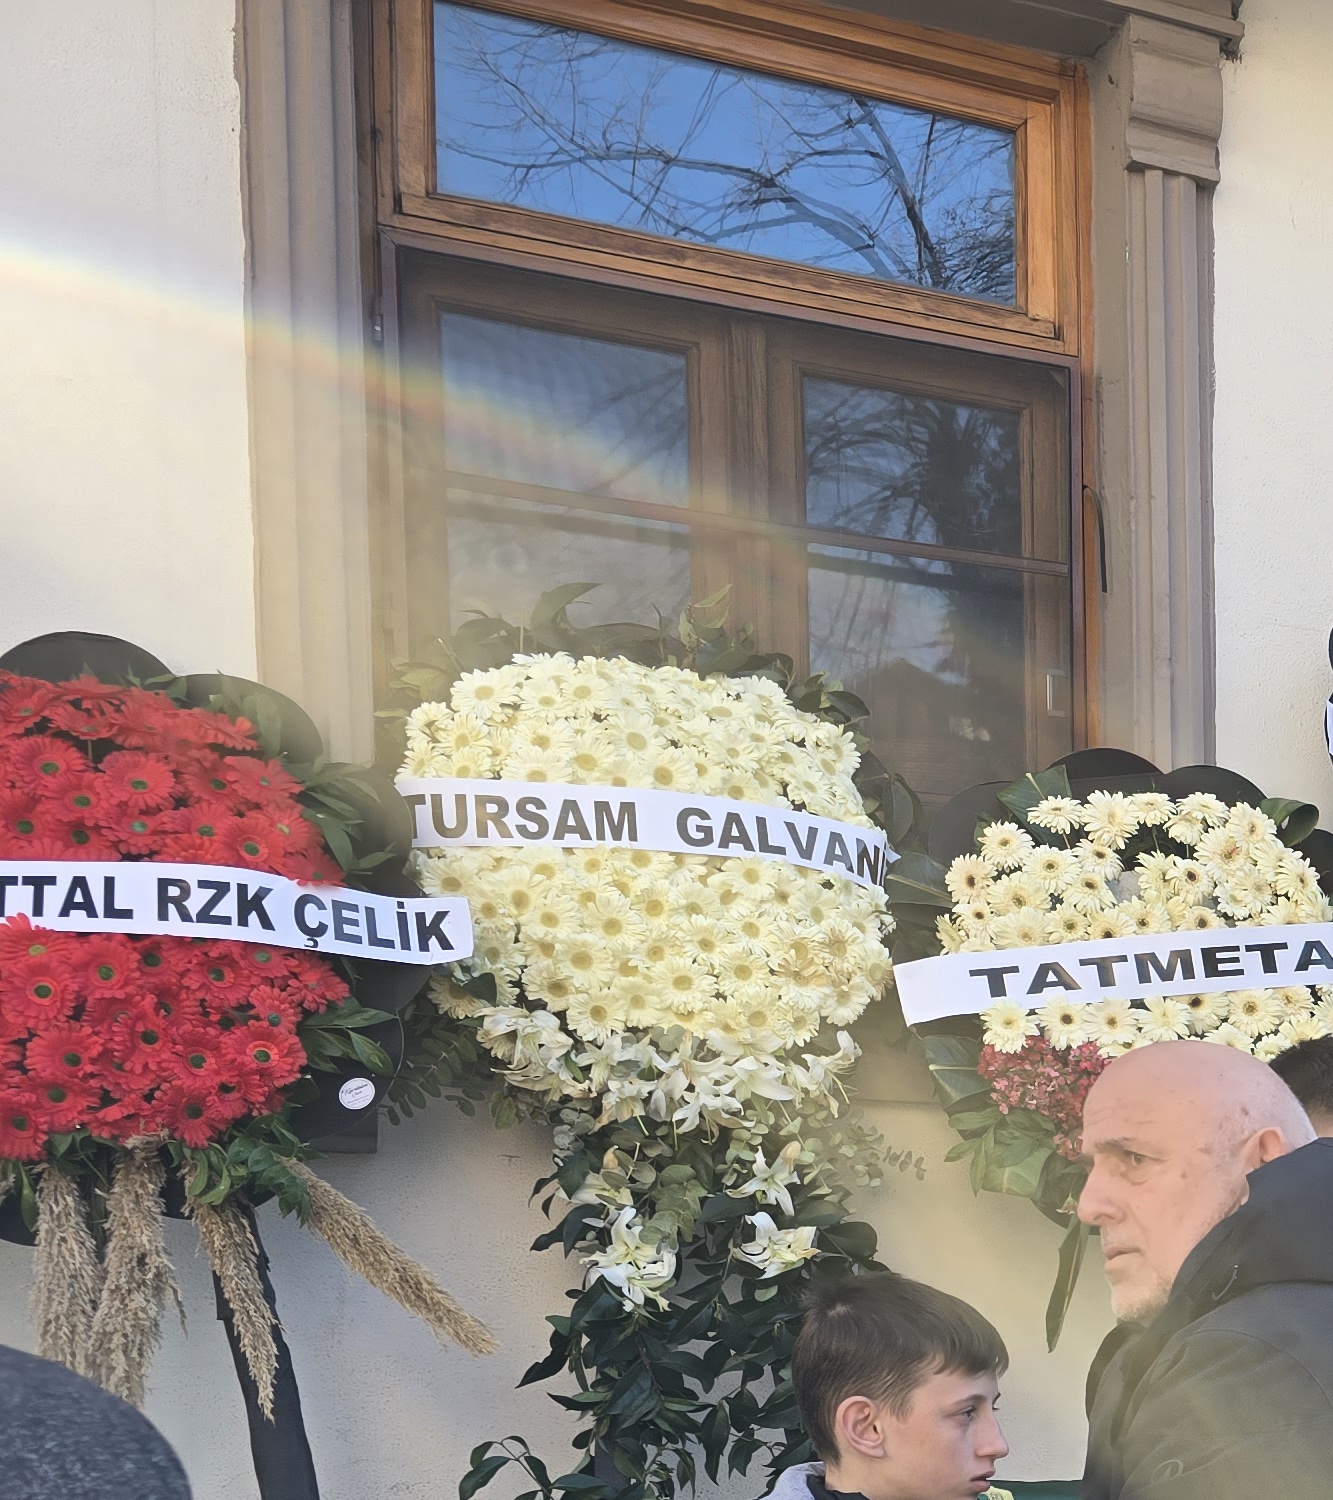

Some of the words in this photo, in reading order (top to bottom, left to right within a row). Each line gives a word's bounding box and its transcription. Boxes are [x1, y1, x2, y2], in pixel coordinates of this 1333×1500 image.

[402, 794, 639, 843] TURSAM
[156, 877, 276, 931] RZK
[293, 893, 456, 953] ÇELİK
